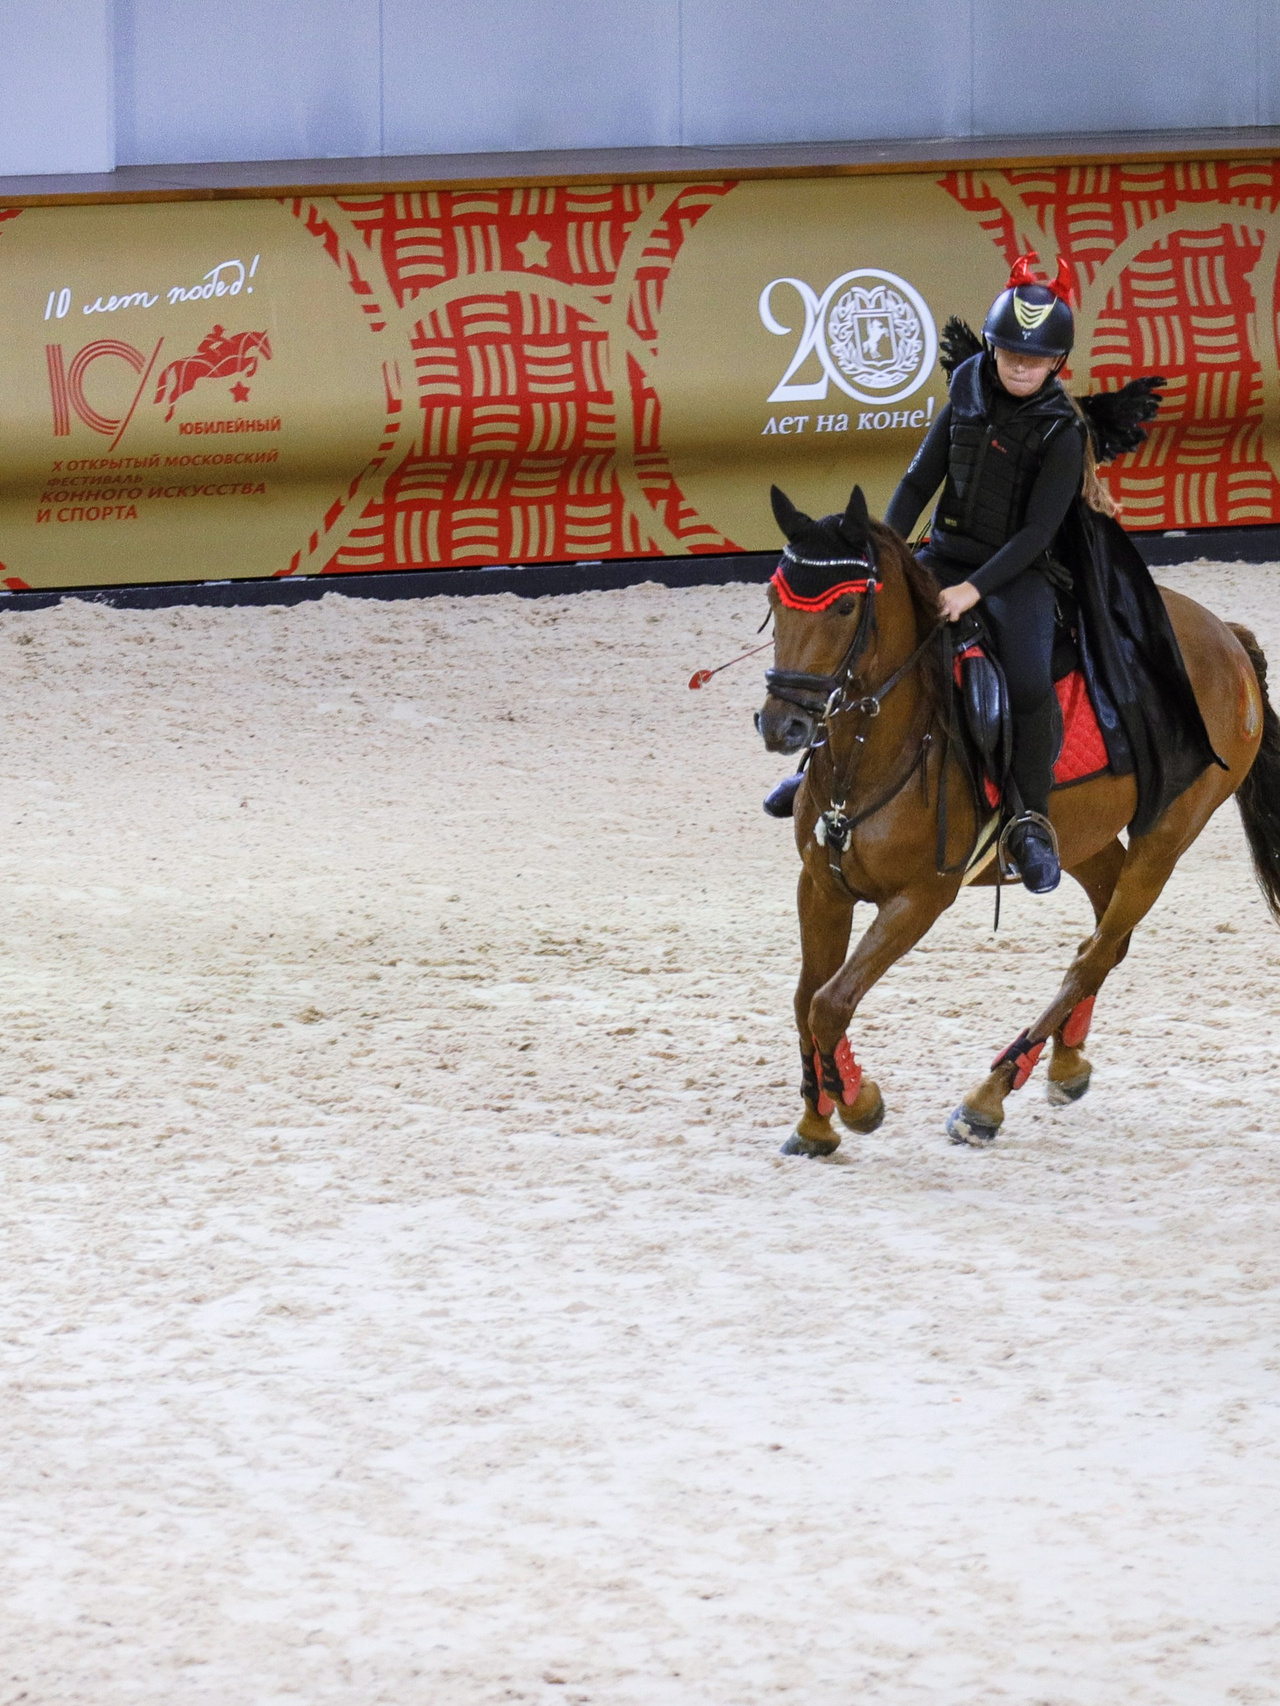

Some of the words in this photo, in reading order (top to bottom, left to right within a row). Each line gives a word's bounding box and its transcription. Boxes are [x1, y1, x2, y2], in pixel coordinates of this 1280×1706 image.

[44, 286, 72, 321] 10
[82, 291, 159, 315] лет
[167, 254, 260, 304] побед!
[758, 267, 939, 405] 20
[178, 415, 282, 436] ЮБИЛЕЙНЫЙ
[761, 415, 810, 436] лет
[814, 413, 849, 433] на
[856, 396, 936, 431] коне!
[66, 453, 161, 472] ОТКРЫТЫЙ
[164, 448, 280, 468] МОСКОВСКИЙ
[45, 474, 144, 487] ФЕСТИВАЛЬ
[40, 486, 143, 504] КОННОГО
[147, 481, 267, 500] ИСКУССТВА
[36, 508, 52, 524] И
[56, 504, 139, 523] СПОРТА
